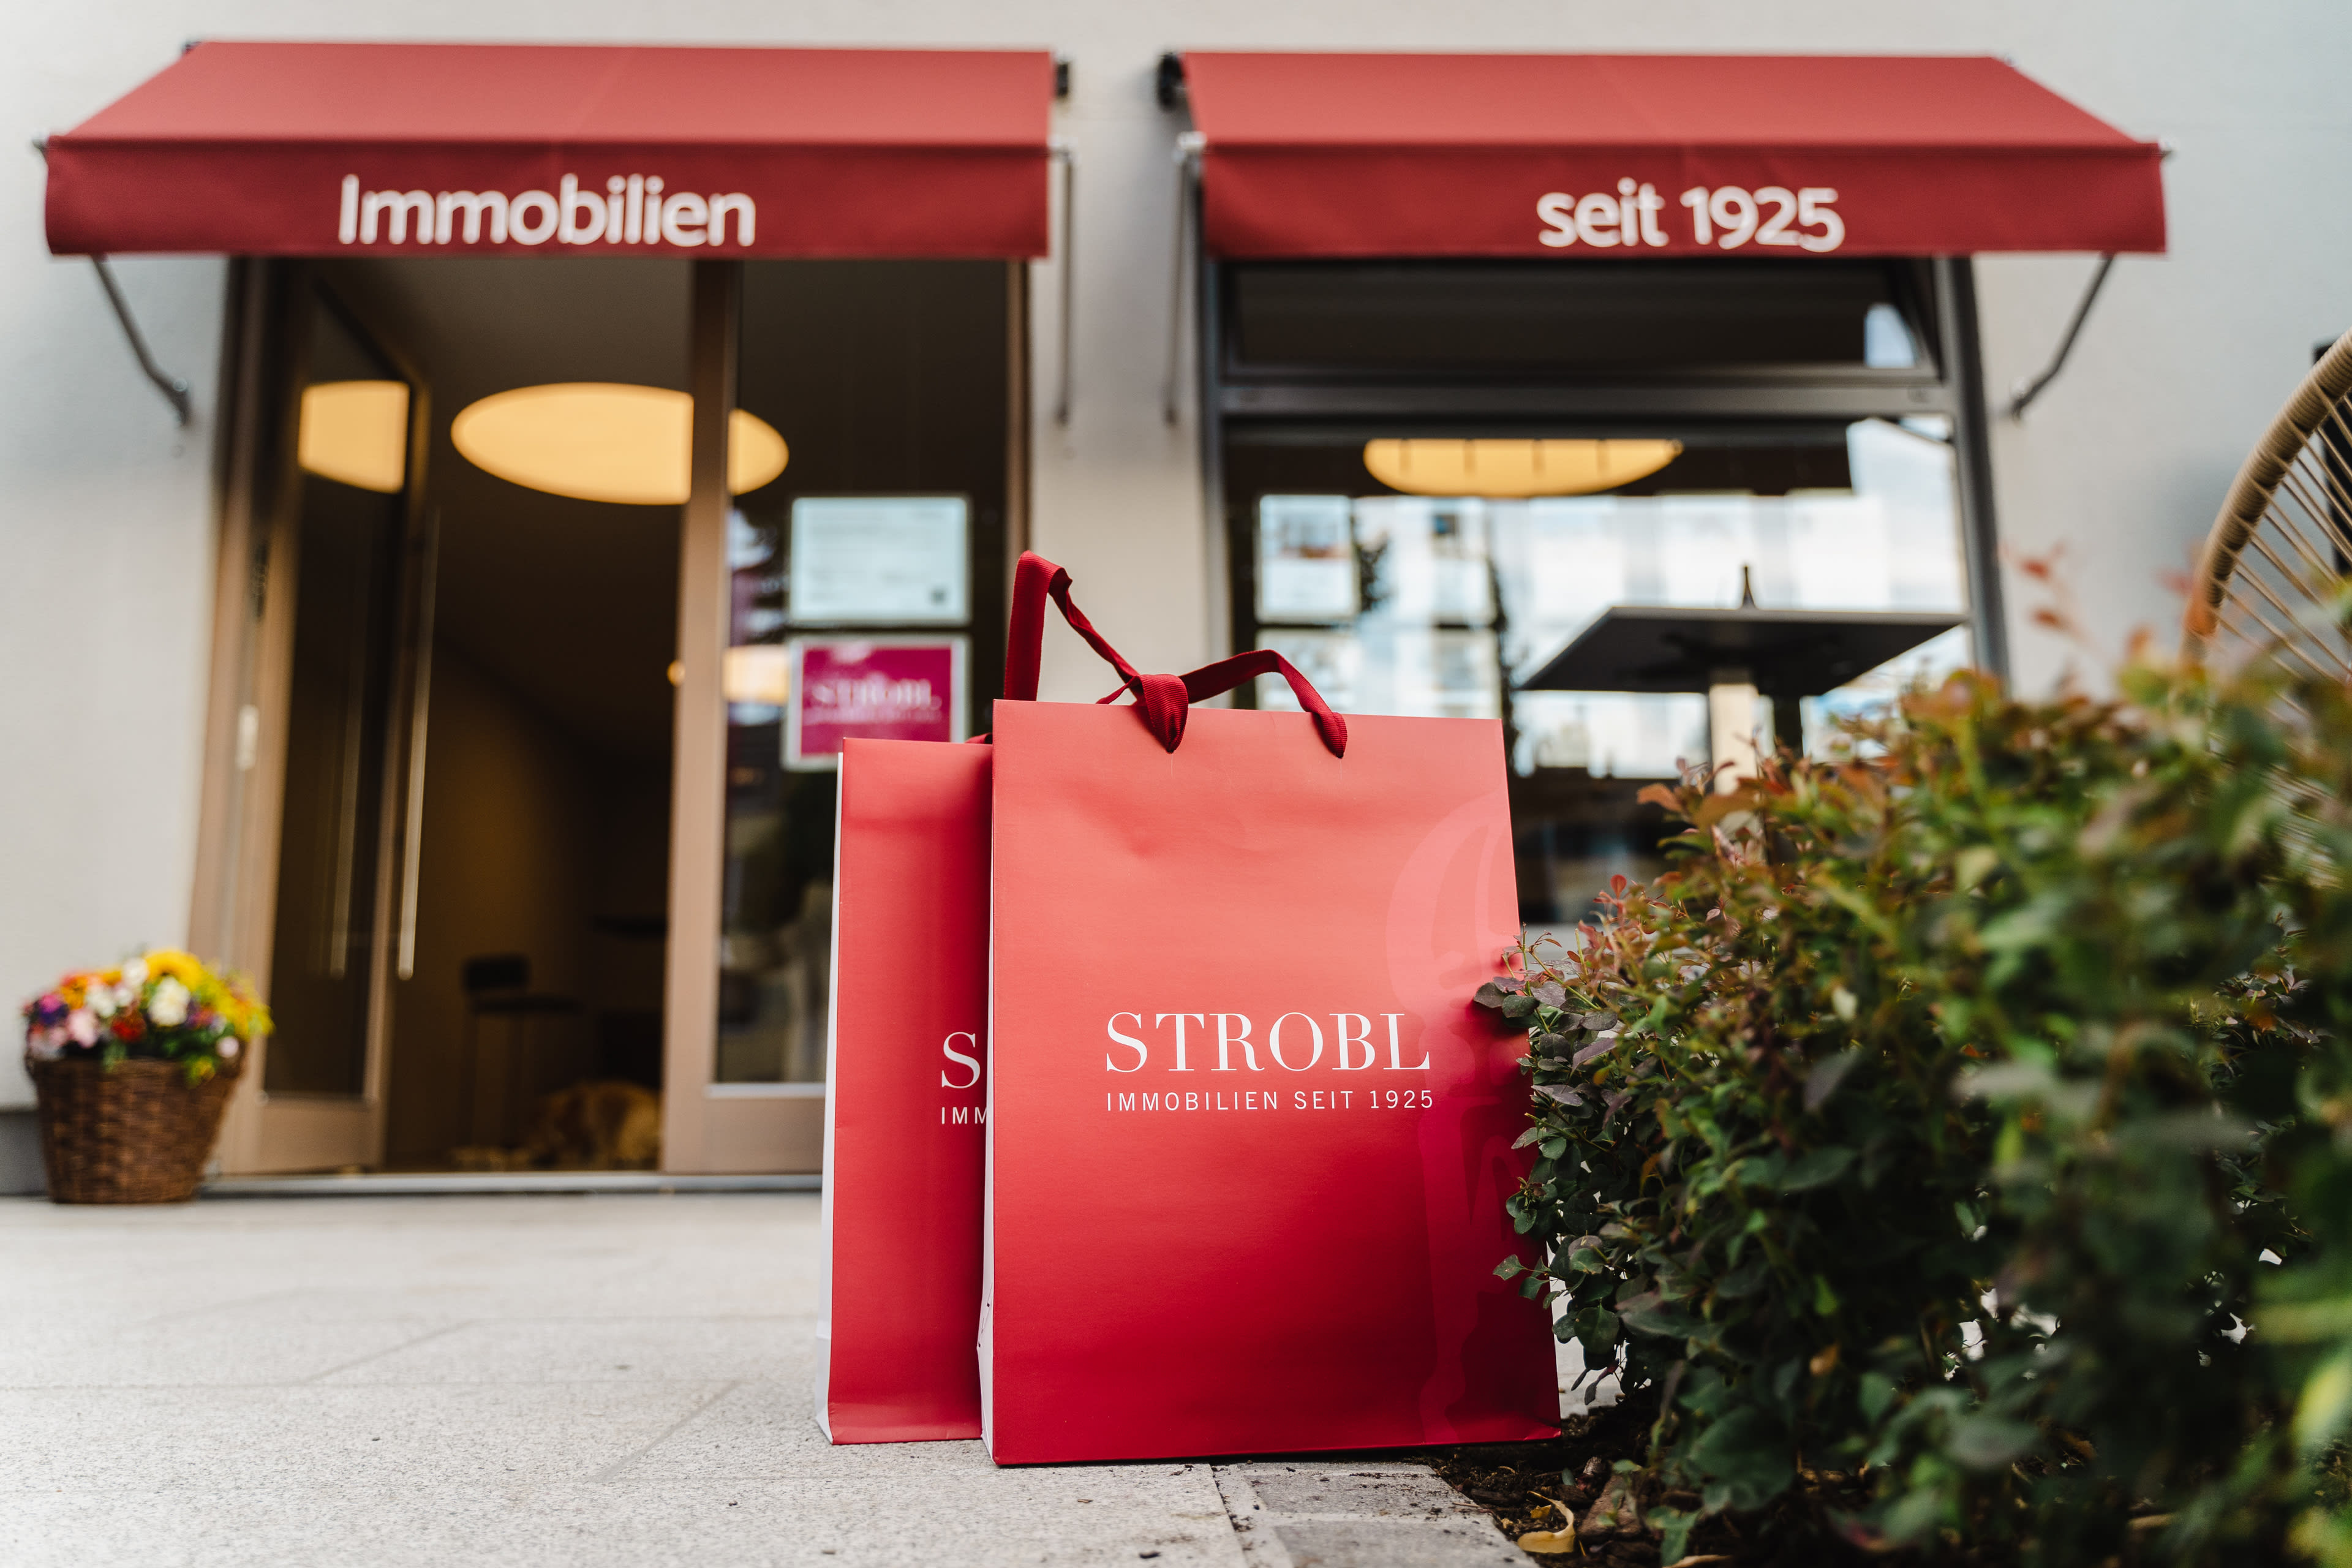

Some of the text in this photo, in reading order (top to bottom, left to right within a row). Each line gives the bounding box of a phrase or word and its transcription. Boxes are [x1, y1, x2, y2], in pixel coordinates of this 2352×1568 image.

[339, 174, 755, 246] Immobilien
[1537, 178, 1845, 252] seit 1925
[1106, 1012, 1430, 1072] STROBL
[1107, 1090, 1433, 1111] IMMOBILIEN SEIT 1925
